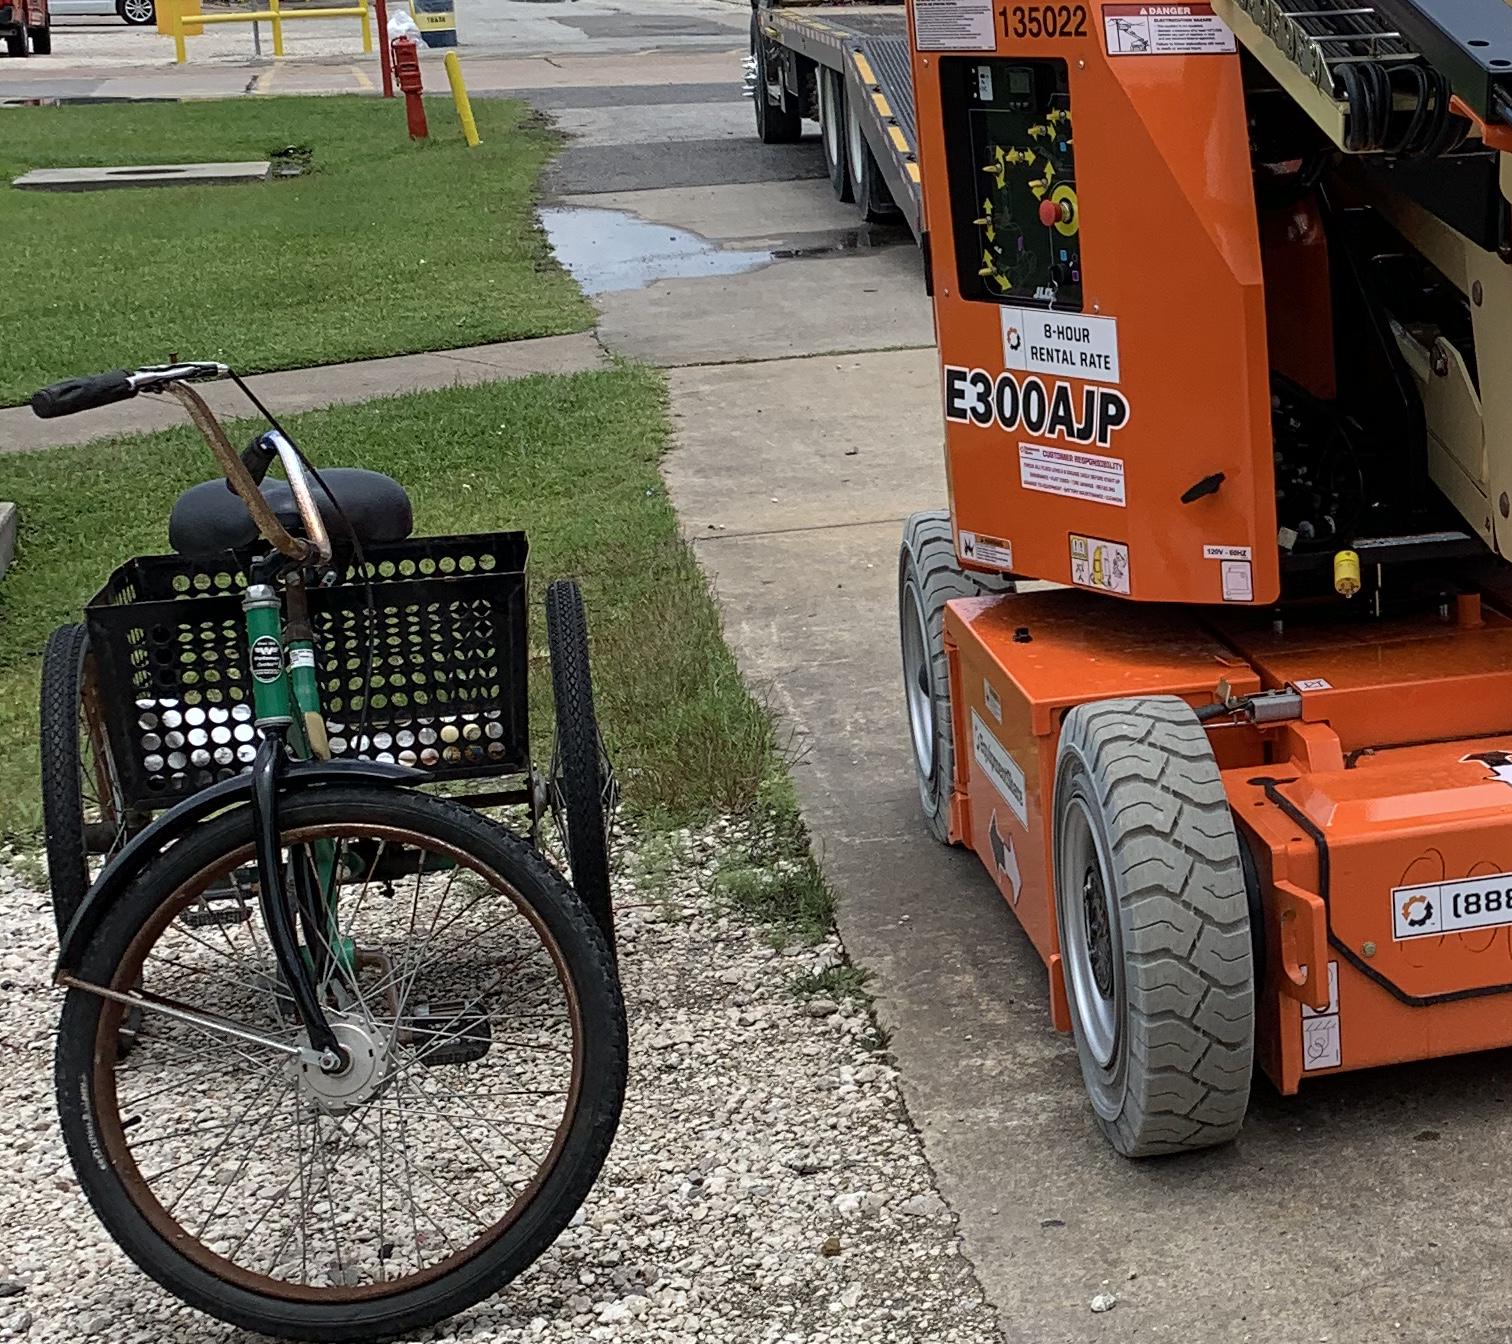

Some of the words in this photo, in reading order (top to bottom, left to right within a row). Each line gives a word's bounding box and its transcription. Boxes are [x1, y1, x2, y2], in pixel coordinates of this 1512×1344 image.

[998, 5, 1088, 38] 135022
[1148, 7, 1192, 15] DANGER
[1043, 323, 1091, 344] 8-HOUR
[1030, 345, 1076, 366] RENTAL
[1080, 351, 1111, 370] RATE
[945, 365, 1130, 447] E300AJP
